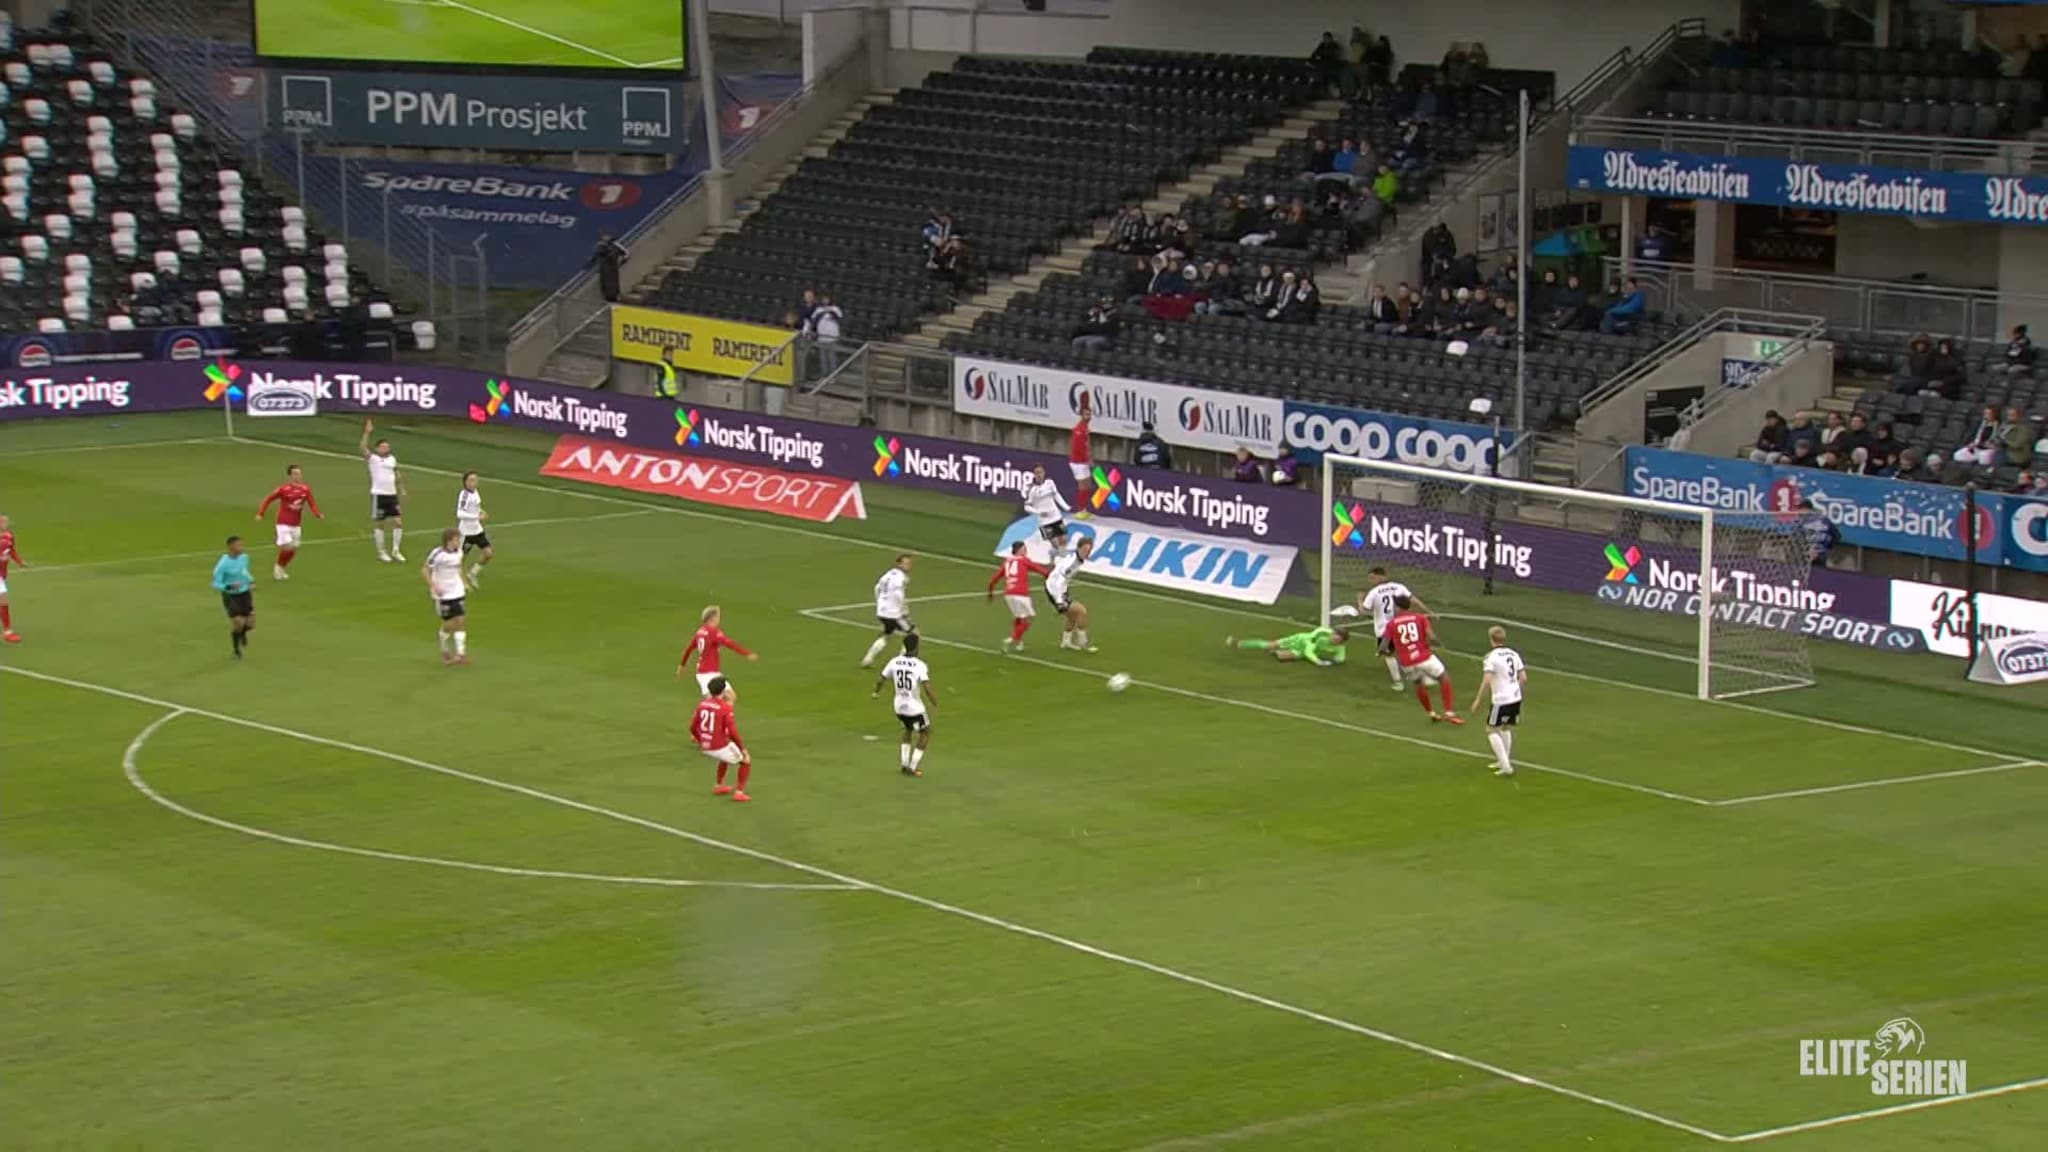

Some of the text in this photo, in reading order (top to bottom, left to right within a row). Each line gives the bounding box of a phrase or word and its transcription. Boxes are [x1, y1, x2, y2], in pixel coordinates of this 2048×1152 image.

[283, 109, 322, 125] PPM
[367, 90, 587, 136] PPM Prosjekt
[622, 121, 661, 137] PPM
[362, 172, 575, 201] SpareBank
[622, 323, 692, 351] RAMIRENT
[25, 377, 130, 409] Tipping
[334, 374, 437, 409] Tipping
[513, 389, 628, 437] Norsk Tipping
[704, 418, 824, 468] Norsk Tipping
[904, 447, 1034, 499] Norsk Tipping
[1633, 467, 1766, 513] SpareBank
[1126, 479, 1269, 535] Norsk Tipping
[1809, 493, 1953, 540] SpareBank
[1370, 515, 1533, 578] Norsk Tipping
[1397, 622, 1419, 644] 29
[1624, 587, 1678, 612] NOR
[1801, 612, 1886, 646] SPORT
[896, 670, 913, 691] 35
[1506, 656, 1515, 677] 3
[700, 709, 715, 733] 21
